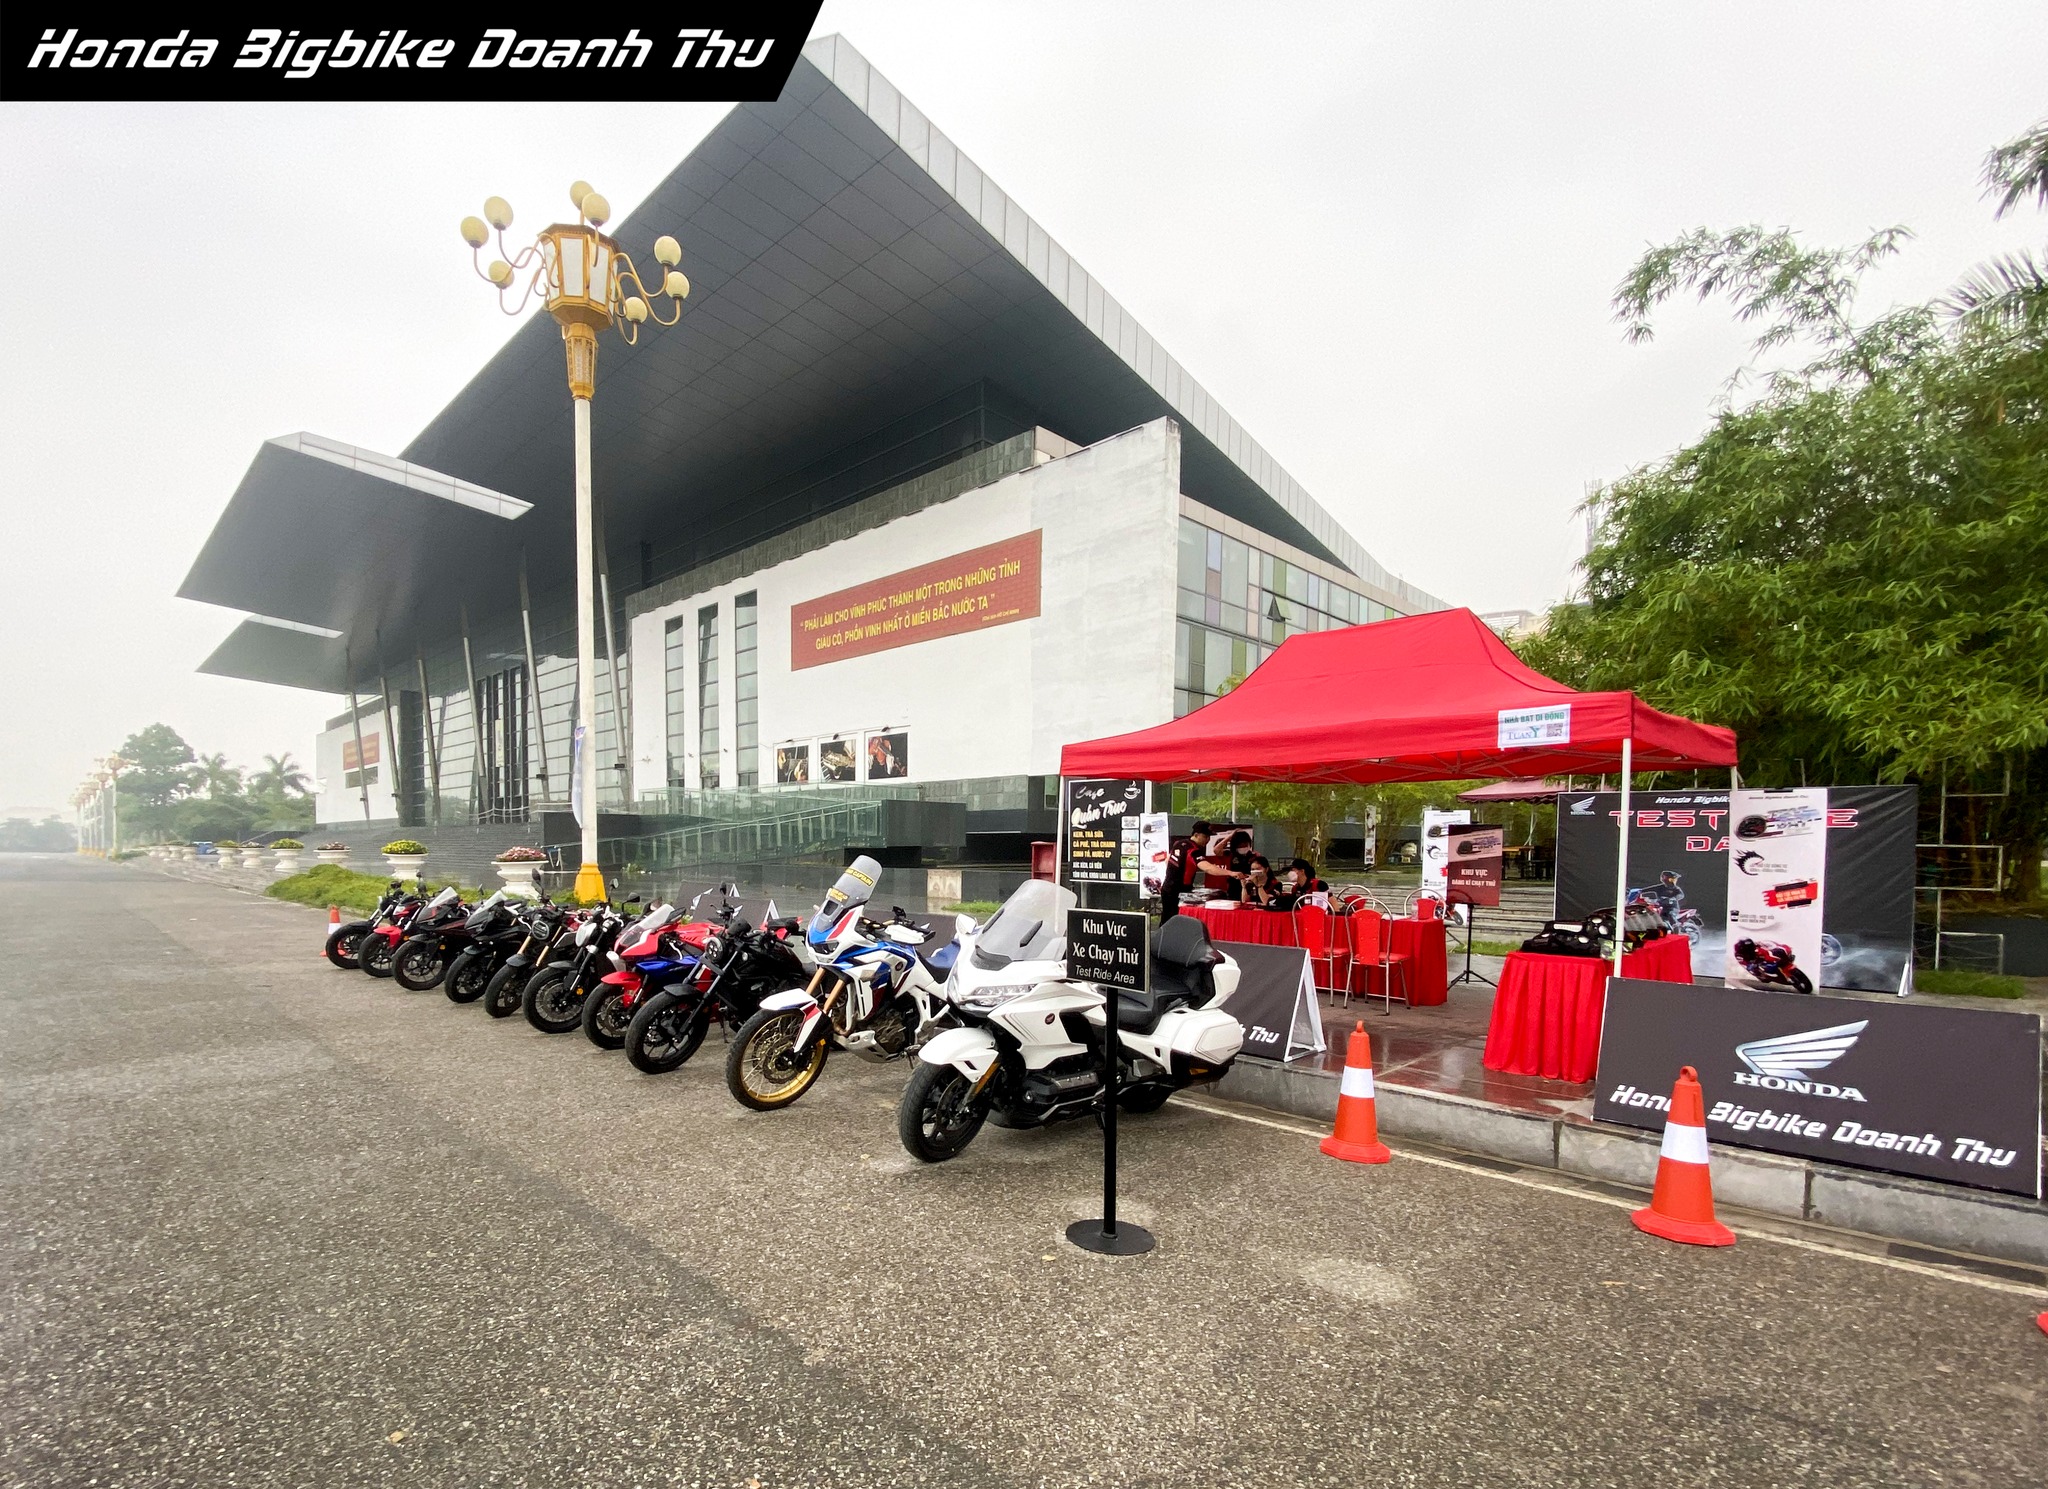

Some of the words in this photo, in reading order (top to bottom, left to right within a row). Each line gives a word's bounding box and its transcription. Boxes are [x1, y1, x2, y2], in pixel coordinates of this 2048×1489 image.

[820, 610, 833, 627] LÀM
[834, 609, 849, 624] CHO
[850, 603, 866, 619] VĨNH
[867, 596, 887, 614] PHÚC
[889, 591, 914, 608] THÀNH
[915, 583, 932, 602] MỘT
[934, 576, 962, 596] TRONG
[965, 567, 996, 588] NHỮNG
[999, 557, 1020, 579] TỈNH
[815, 634, 831, 650] GIÀU
[844, 624, 863, 643] PHỒN
[865, 622, 881, 638] VINH
[883, 612, 903, 634] NHẤT
[932, 601, 949, 621] BẮC
[951, 597, 976, 617] NƯỚC
[977, 595, 988, 611] TA
[1655, 796, 1691, 804] Honda
[1693, 795, 1730, 804] Bigbik
[1686, 836, 1730, 852] DA
[1461, 868, 1473, 876] KHU
[1083, 918, 1104, 935] Khu
[1106, 920, 1127, 940] Vực
[1072, 942, 1085, 958] Xe
[1088, 944, 1115, 965] Chạy
[1117, 947, 1139, 965] Thử
[1075, 965, 1091, 978] Test
[1093, 967, 1112, 980] Ride
[1113, 971, 1135, 984] Area
[1248, 1025, 1280, 1043] Thu
[1733, 1071, 1867, 1103] HONDA
[1610, 1084, 1671, 1112] Hon
[1707, 1101, 1827, 1138] Bigbike
[1831, 1121, 1942, 1156] Doanh
[1951, 1137, 2017, 1166] Thu
